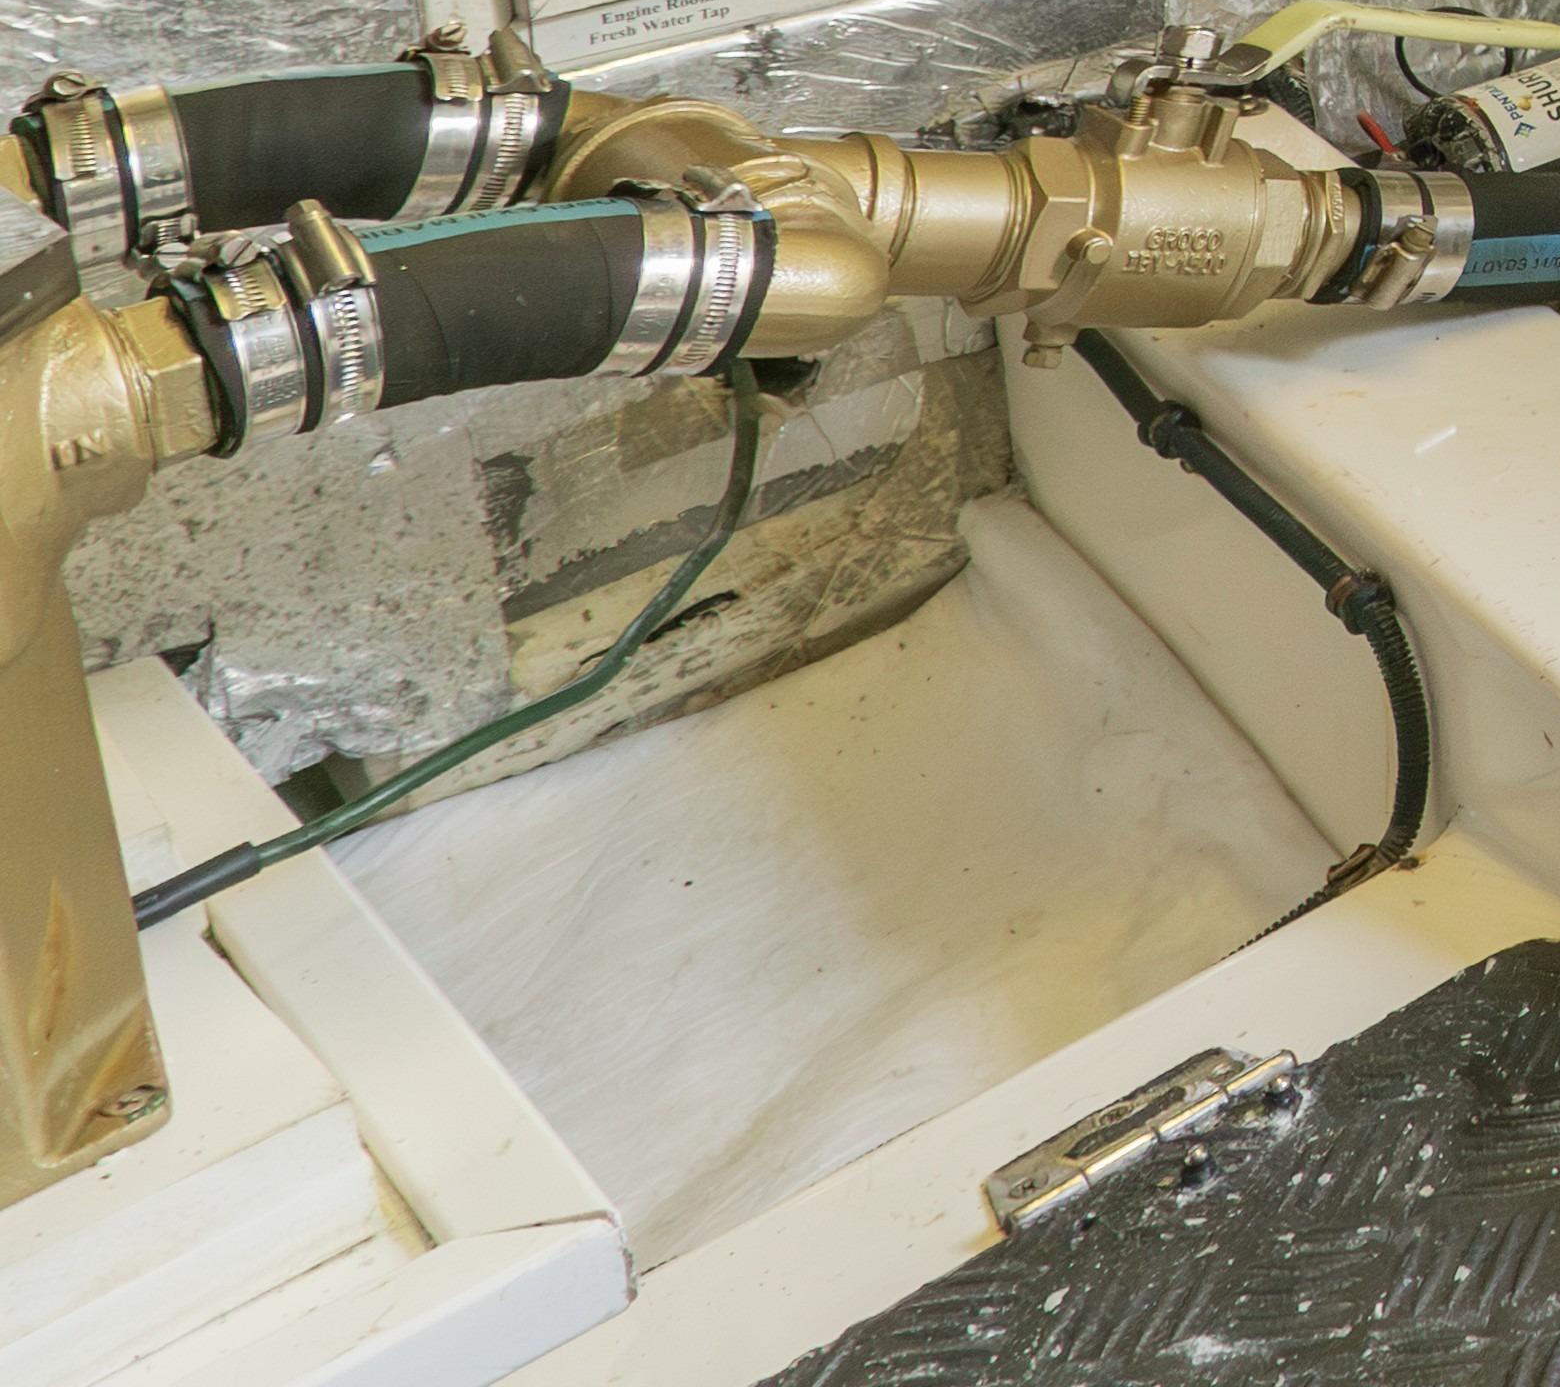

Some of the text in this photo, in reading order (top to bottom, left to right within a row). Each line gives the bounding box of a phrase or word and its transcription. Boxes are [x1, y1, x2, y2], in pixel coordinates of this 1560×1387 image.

[590, 6, 731, 45] Fresh Water Tap
[602, 5, 661, 26] Engine
